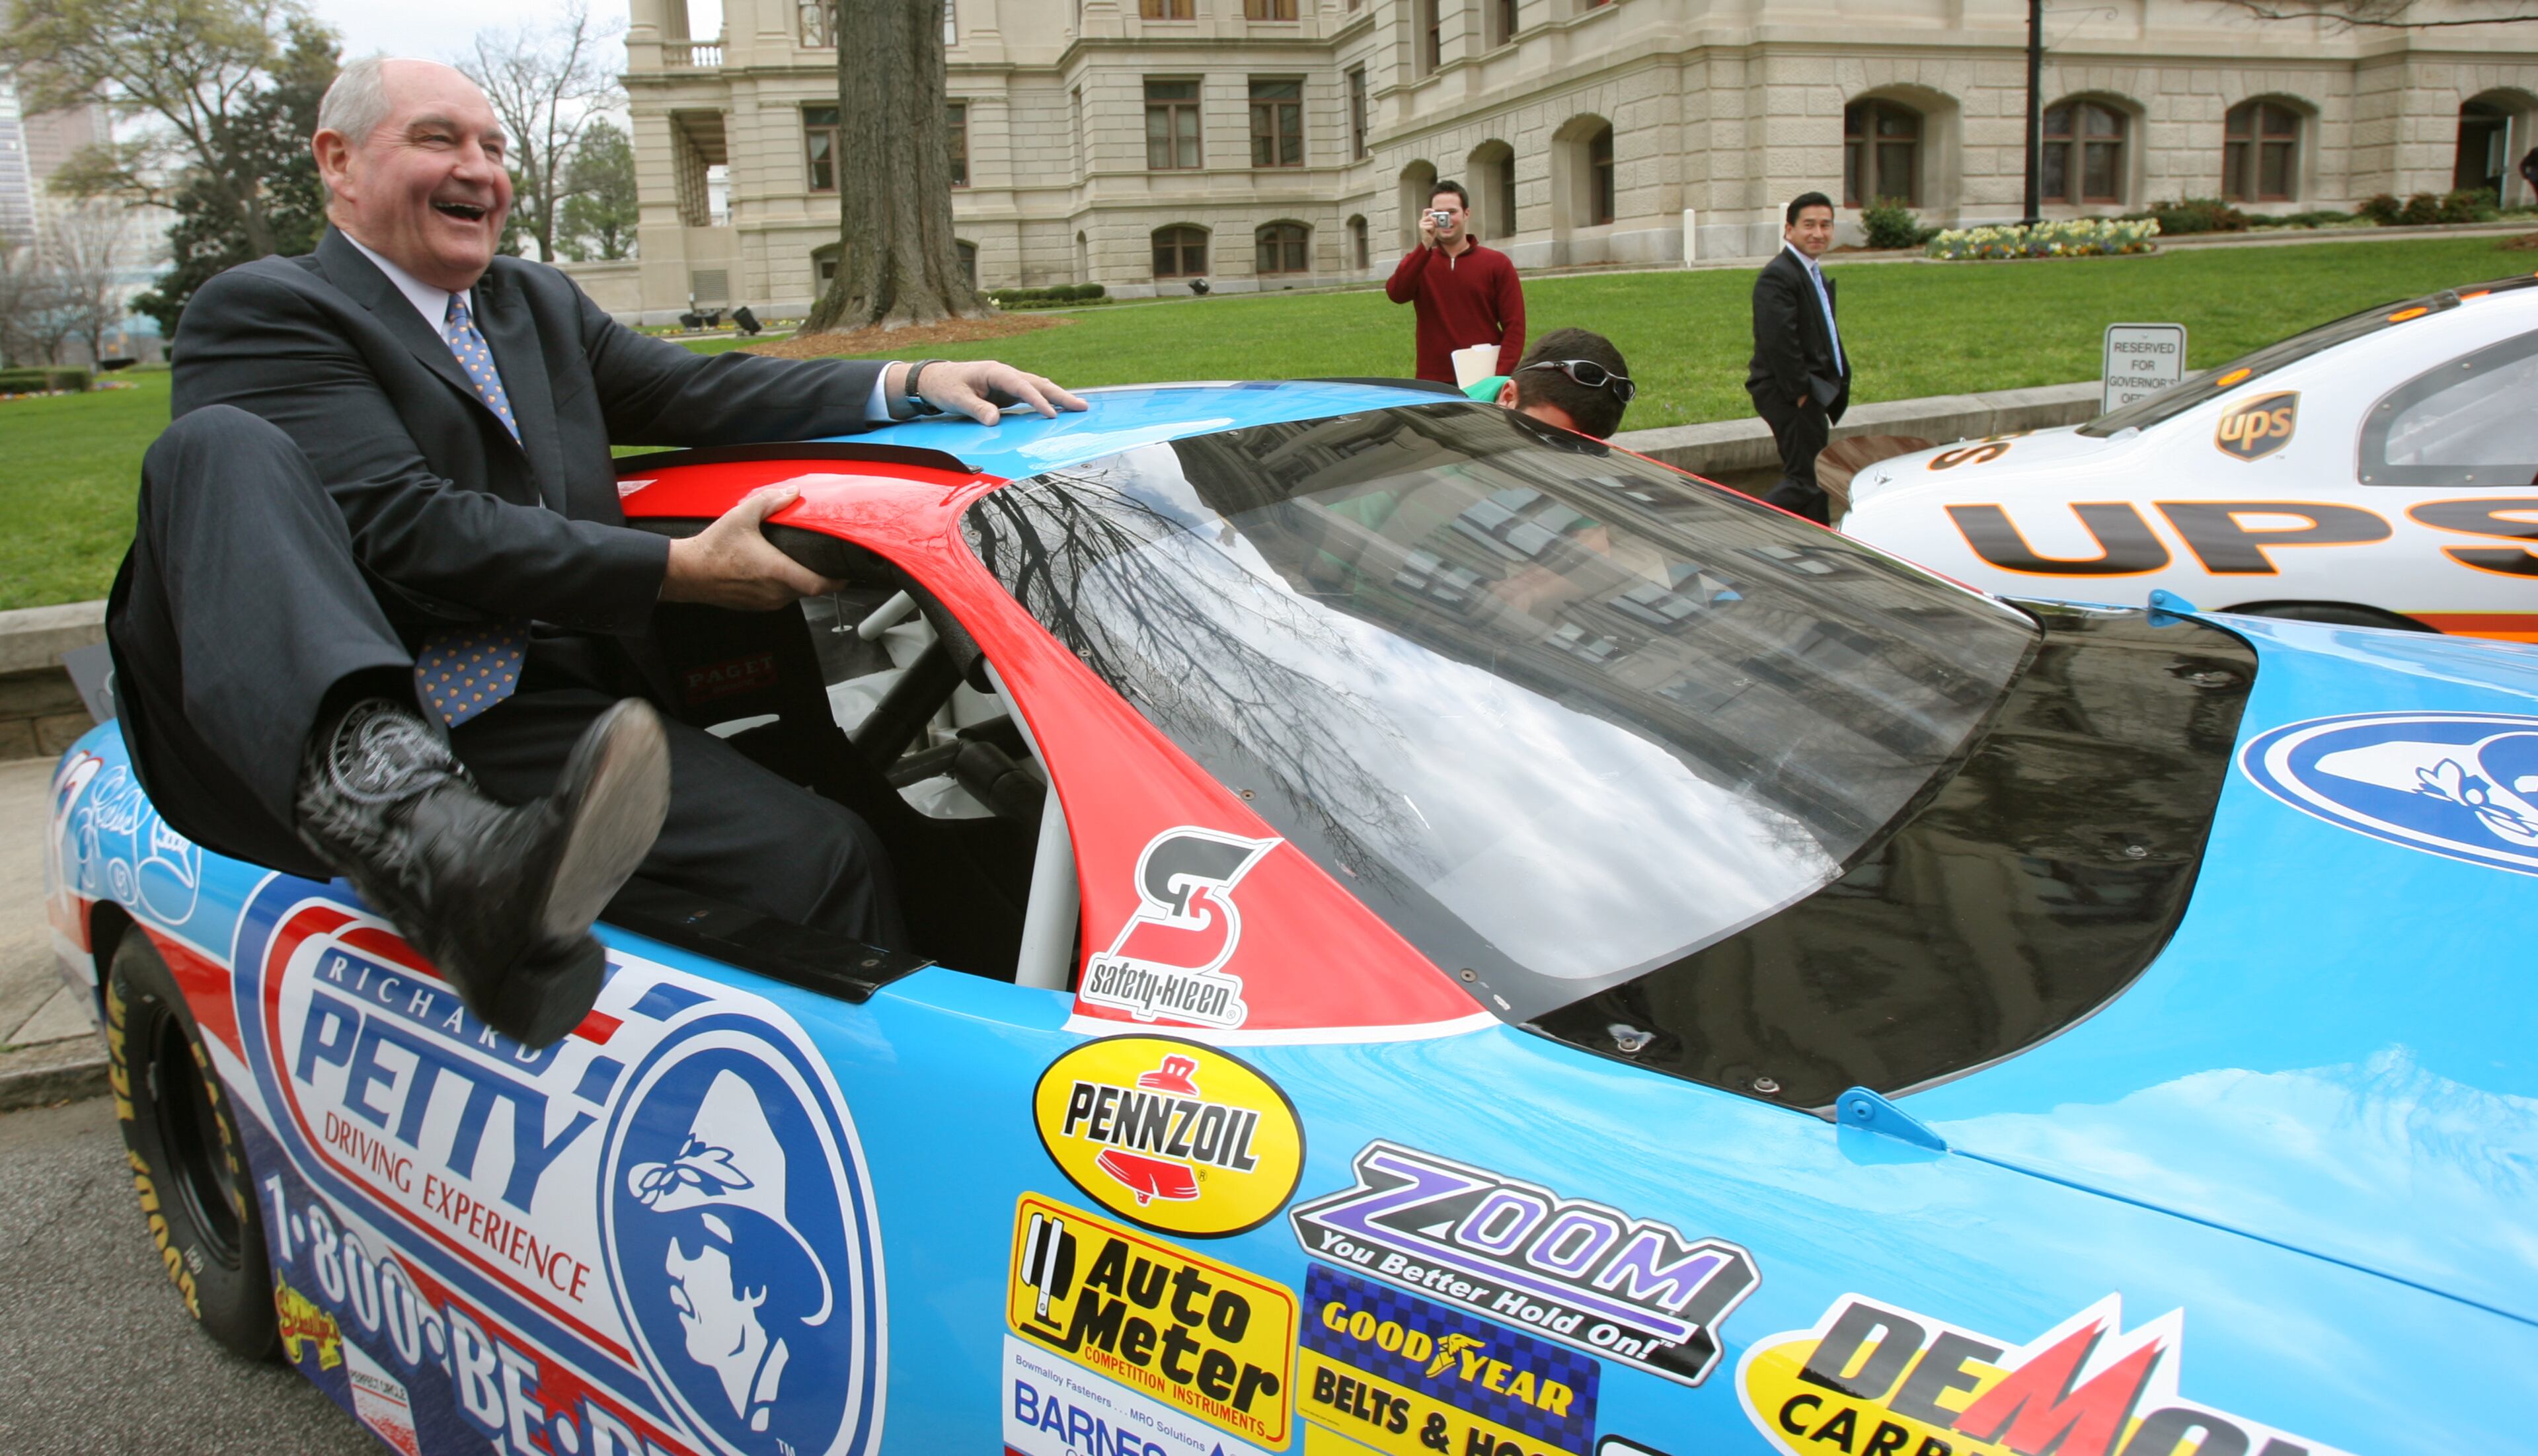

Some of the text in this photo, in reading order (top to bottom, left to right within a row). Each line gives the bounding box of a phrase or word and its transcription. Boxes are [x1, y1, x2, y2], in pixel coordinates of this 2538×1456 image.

[2114, 342, 2176, 354] RESERVED
[2132, 360, 2155, 371] FOR
[2219, 406, 2293, 451] ups
[1944, 498, 2538, 578] UPS
[687, 655, 773, 688] PAGET
[328, 956, 543, 1063] RICHARD
[295, 989, 599, 1216] PETTY
[1061, 1081, 1260, 1172] PENNZOIL
[325, 1111, 591, 1303] DRIVING EXPERIENCE
[1301, 1150, 1734, 1327] ZOOM
[1085, 1237, 1251, 1344] Auto
[1319, 1229, 1375, 1265] You
[1378, 1252, 1490, 1303] Better
[1490, 1289, 1585, 1335] Hold
[1588, 1323, 1661, 1360] On!
[1065, 1286, 1280, 1414] Meter
[1085, 1346, 1266, 1437] COMPETITION INSTRUMENTS
[1322, 1301, 1574, 1419] GOOD YEAR
[1797, 1301, 2311, 1456] DEM
[1015, 1355, 1063, 1387] Bowmalloy
[1065, 1379, 1112, 1408] Fasteners
[1130, 1407, 1155, 1428] MRO
[1156, 1420, 1206, 1453] Solutions
[1015, 1379, 1168, 1456] BARNE
[1312, 1365, 1410, 1435] BELTS
[1420, 1412, 1452, 1456] &
[1779, 1393, 1973, 1456] CAR
